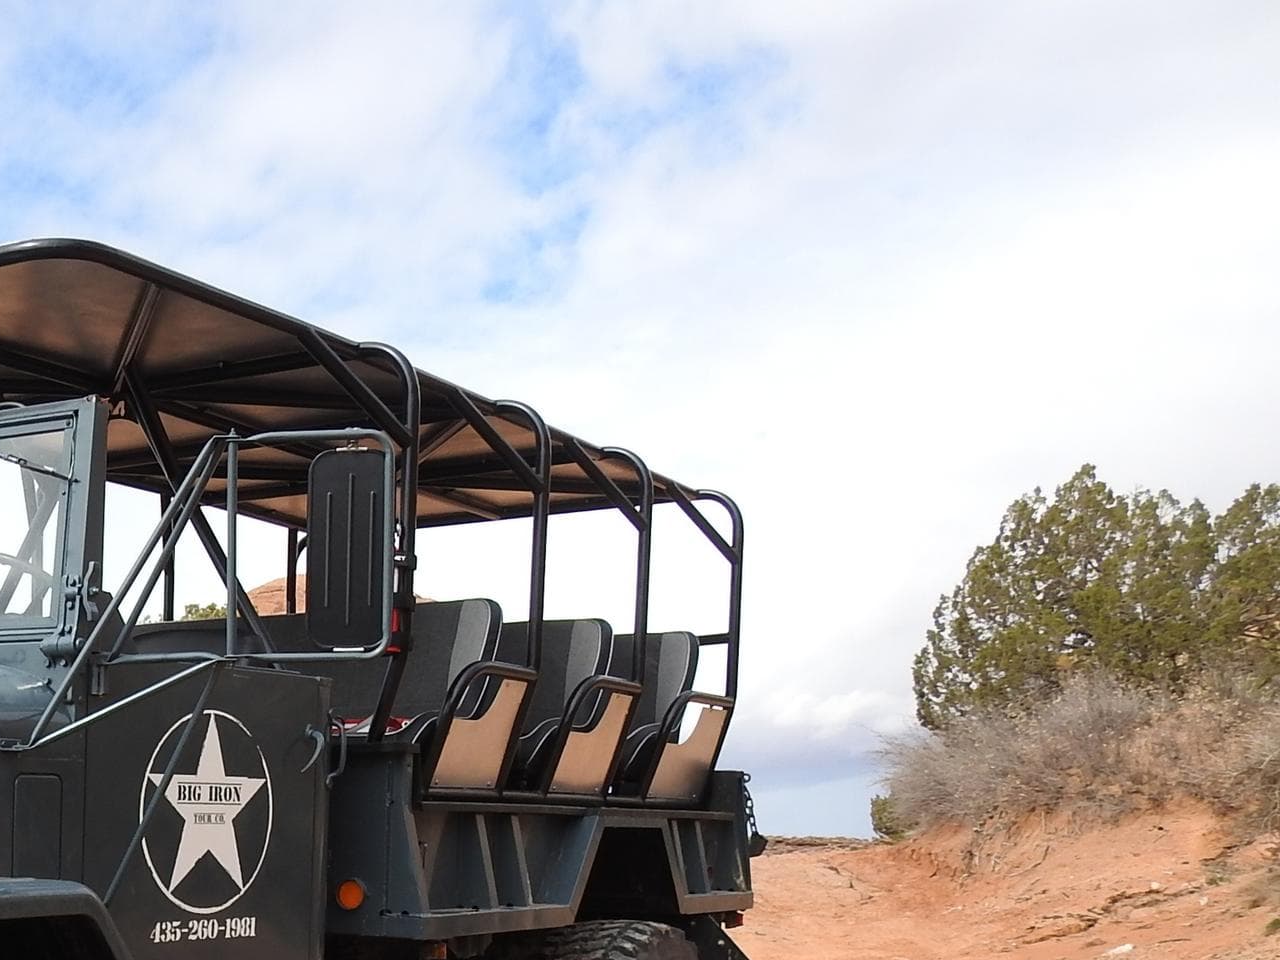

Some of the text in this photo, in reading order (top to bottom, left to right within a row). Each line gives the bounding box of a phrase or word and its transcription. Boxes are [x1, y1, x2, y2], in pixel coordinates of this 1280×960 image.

[177, 785, 242, 802] BIG IRON
[194, 814, 212, 824] TOUR
[150, 917, 256, 943] 435-260-1981
